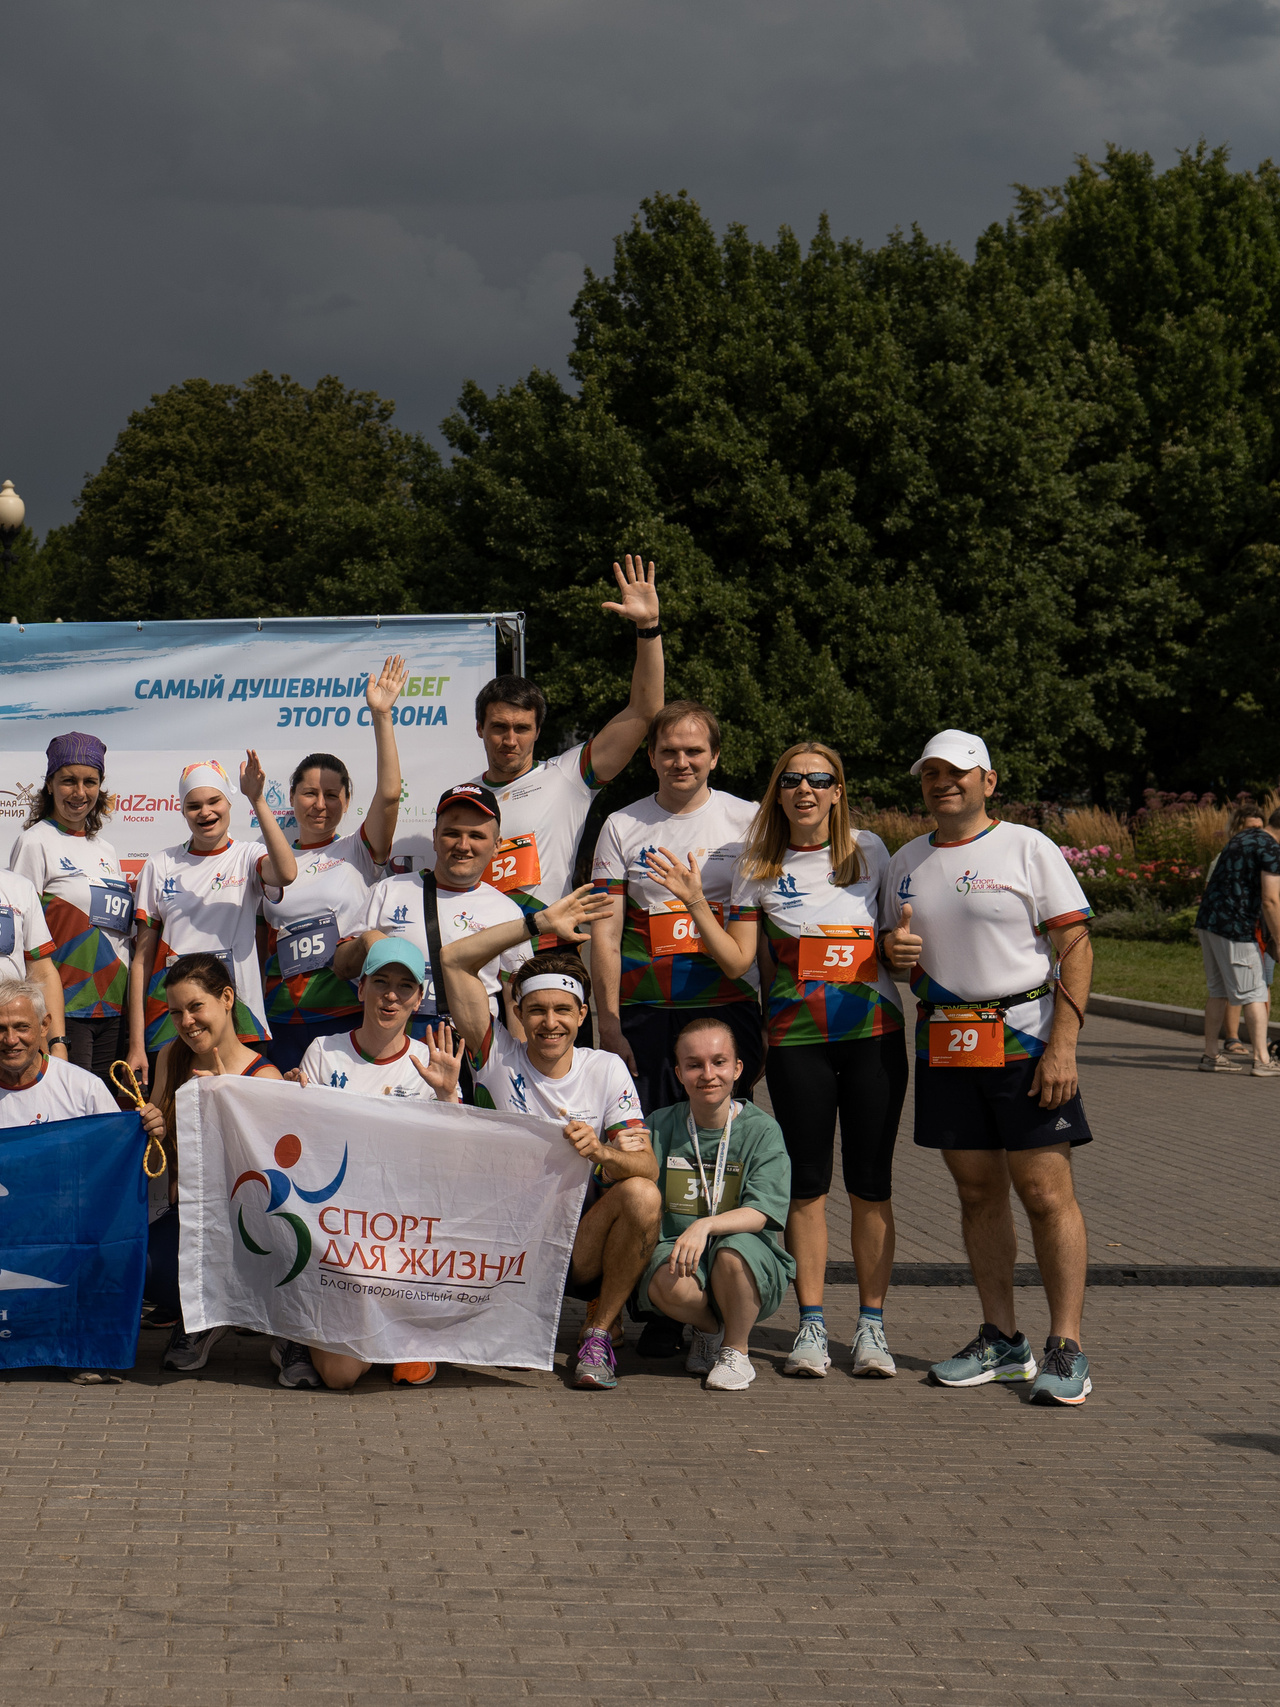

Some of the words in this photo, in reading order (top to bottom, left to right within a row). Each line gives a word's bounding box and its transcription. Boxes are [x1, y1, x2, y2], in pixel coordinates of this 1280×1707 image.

[134, 673, 225, 700] САМЫЙ
[228, 672, 370, 702] ДУШЕВНЫЙ
[276, 706, 351, 727] ЭТОГО
[357, 705, 448, 727] СЗОНА
[123, 815, 154, 823] Москва
[491, 856, 517, 882] 52
[104, 894, 130, 918] 197
[289, 933, 326, 960] 195
[823, 945, 855, 967] 53
[947, 1028, 979, 1052] 29
[318, 1205, 442, 1244] СПОРТ
[319, 1239, 388, 1273] ДЛЯ
[397, 1246, 528, 1282] ЖИЗНИ
[320, 1274, 452, 1302] Благотворительный
